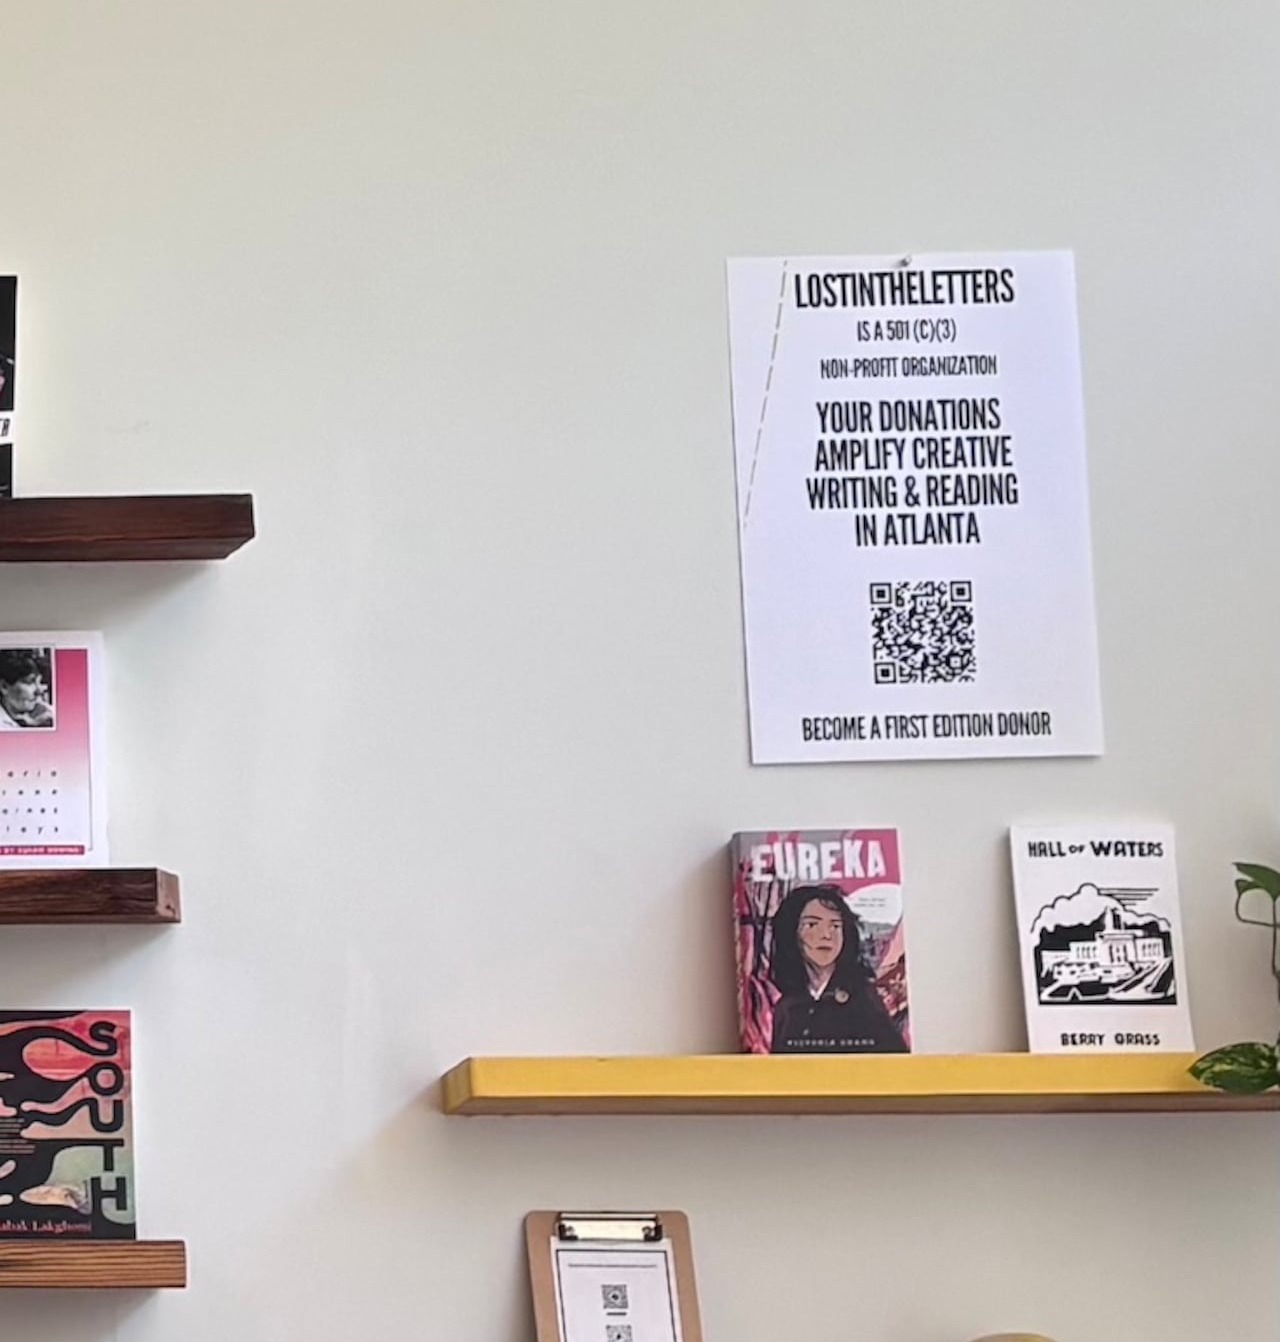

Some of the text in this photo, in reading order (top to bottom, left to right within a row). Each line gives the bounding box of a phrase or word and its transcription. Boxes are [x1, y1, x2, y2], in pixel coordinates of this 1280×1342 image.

[794, 268, 1014, 308] LOSTINTHELETTERS
[857, 317, 957, 343] IS A 501 (C)(3)
[821, 355, 997, 379] NON-PROFIT ORGANIZATION
[816, 398, 1001, 433] YOUR DONATIONS
[815, 436, 1013, 471] AMPLIFY CREATIVE
[806, 473, 1019, 509] WRITING & READING
[856, 512, 981, 546] IN ATLANTA
[802, 712, 1052, 741] BECOME A FIRST EDITION DONOR
[751, 838, 886, 883] EUREKA
[1028, 840, 1066, 858] HALL
[1089, 840, 1164, 858] WATERS
[1061, 1032, 1161, 1047] BERRY GRASS
[88, 1021, 128, 1212] SOUTH
